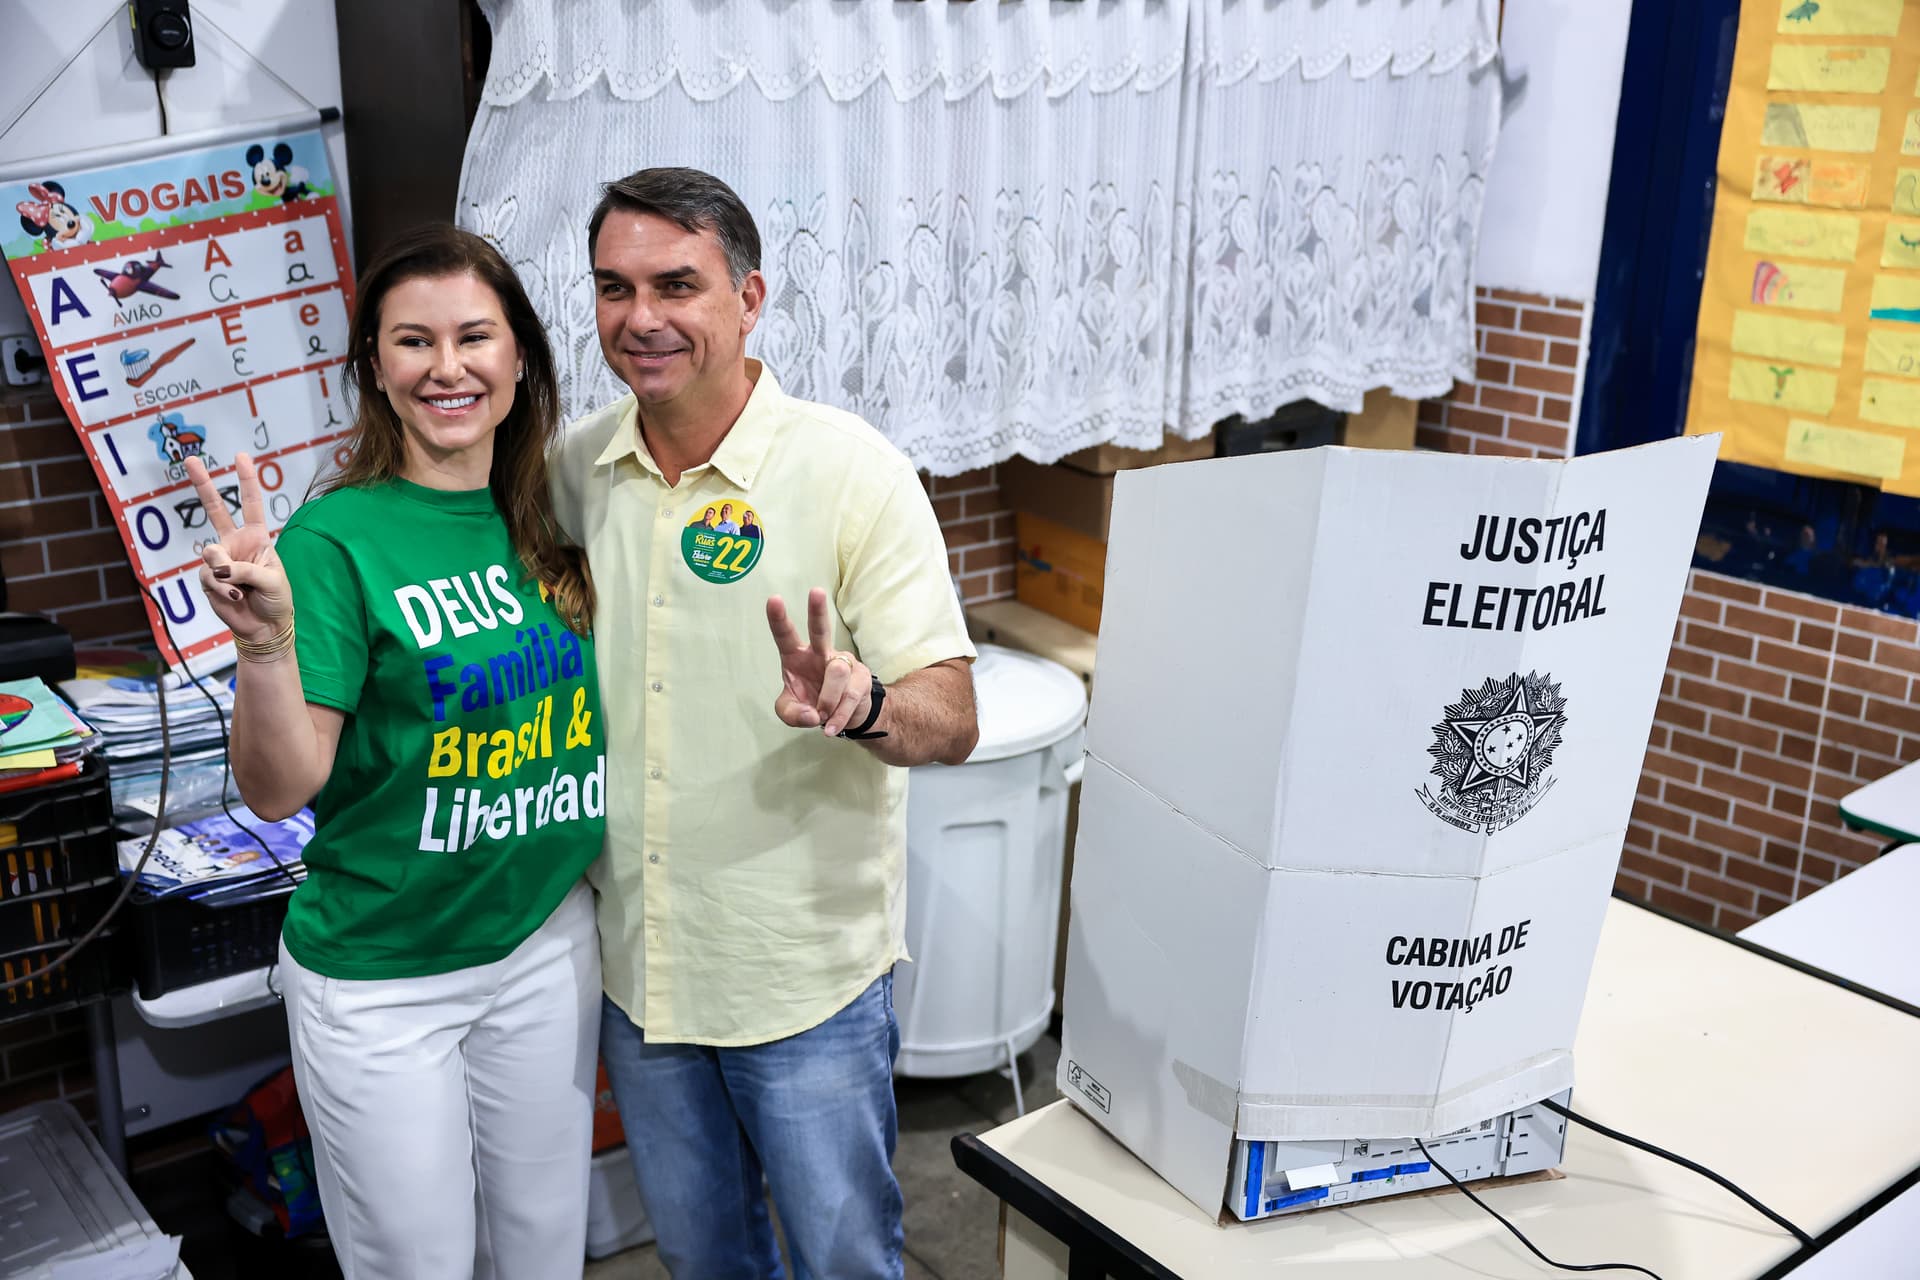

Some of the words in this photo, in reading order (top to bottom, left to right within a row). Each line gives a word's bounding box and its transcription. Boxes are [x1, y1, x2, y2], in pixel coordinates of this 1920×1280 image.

[89, 170, 246, 223] VOGAIS
[203, 239, 233, 272] A
[283, 230, 305, 254] a
[51, 277, 92, 326] A
[113, 303, 163, 328] AVIÃO
[299, 303, 321, 327] e
[220, 312, 248, 346] E
[65, 352, 109, 401] E
[134, 378, 202, 407] ESCOVA
[103, 433, 128, 476] I
[258, 461, 284, 492] O
[136, 506, 170, 551] O
[1460, 508, 1606, 570] JUSTIÇA
[712, 536, 752, 573] 22
[157, 578, 196, 624] U
[393, 564, 524, 649] DEUS
[1422, 574, 1607, 632] ELEITORAL
[424, 623, 584, 722] Família
[428, 695, 553, 779] Brasil
[565, 686, 592, 750] &
[1385, 932, 1492, 968] CABINA
[1497, 919, 1531, 956] DE
[1391, 965, 1513, 1014] VOTAÇÃO
